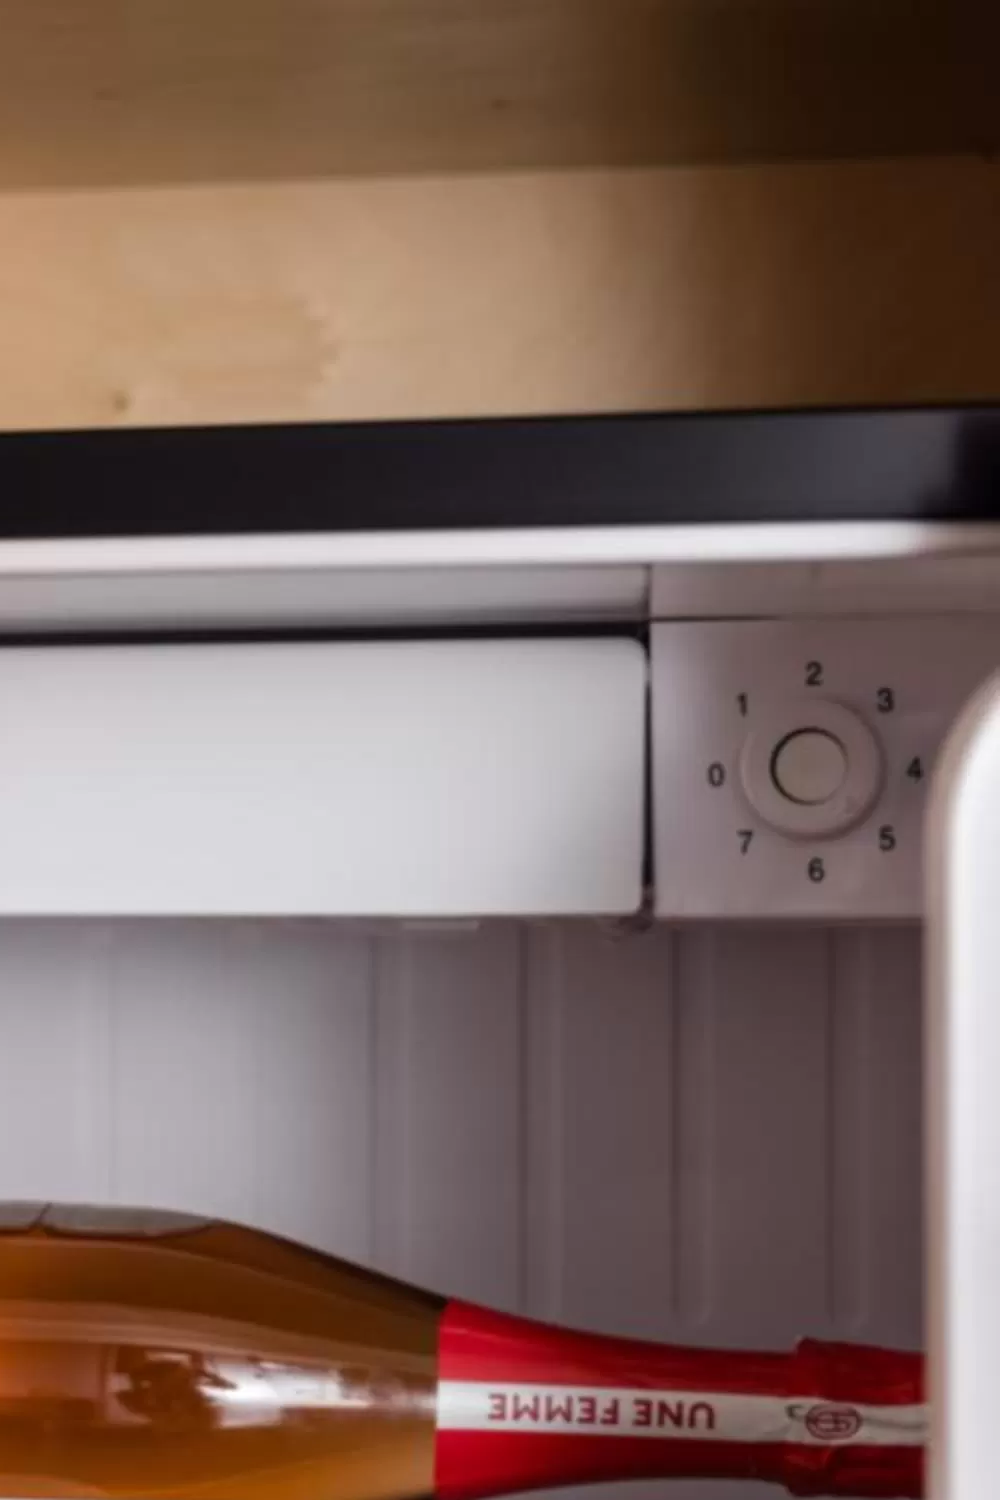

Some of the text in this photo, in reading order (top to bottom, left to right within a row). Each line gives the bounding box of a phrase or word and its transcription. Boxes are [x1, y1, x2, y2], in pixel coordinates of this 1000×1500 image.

[804, 660, 824, 687] 2
[736, 691, 749, 718] 1
[876, 686, 896, 714] 3
[706, 761, 726, 788] 0
[905, 755, 922, 783] 4
[736, 829, 754, 856] 7
[878, 824, 897, 852] 5
[806, 856, 826, 883] 6
[487, 1392, 715, 1430] UNE FEMME
